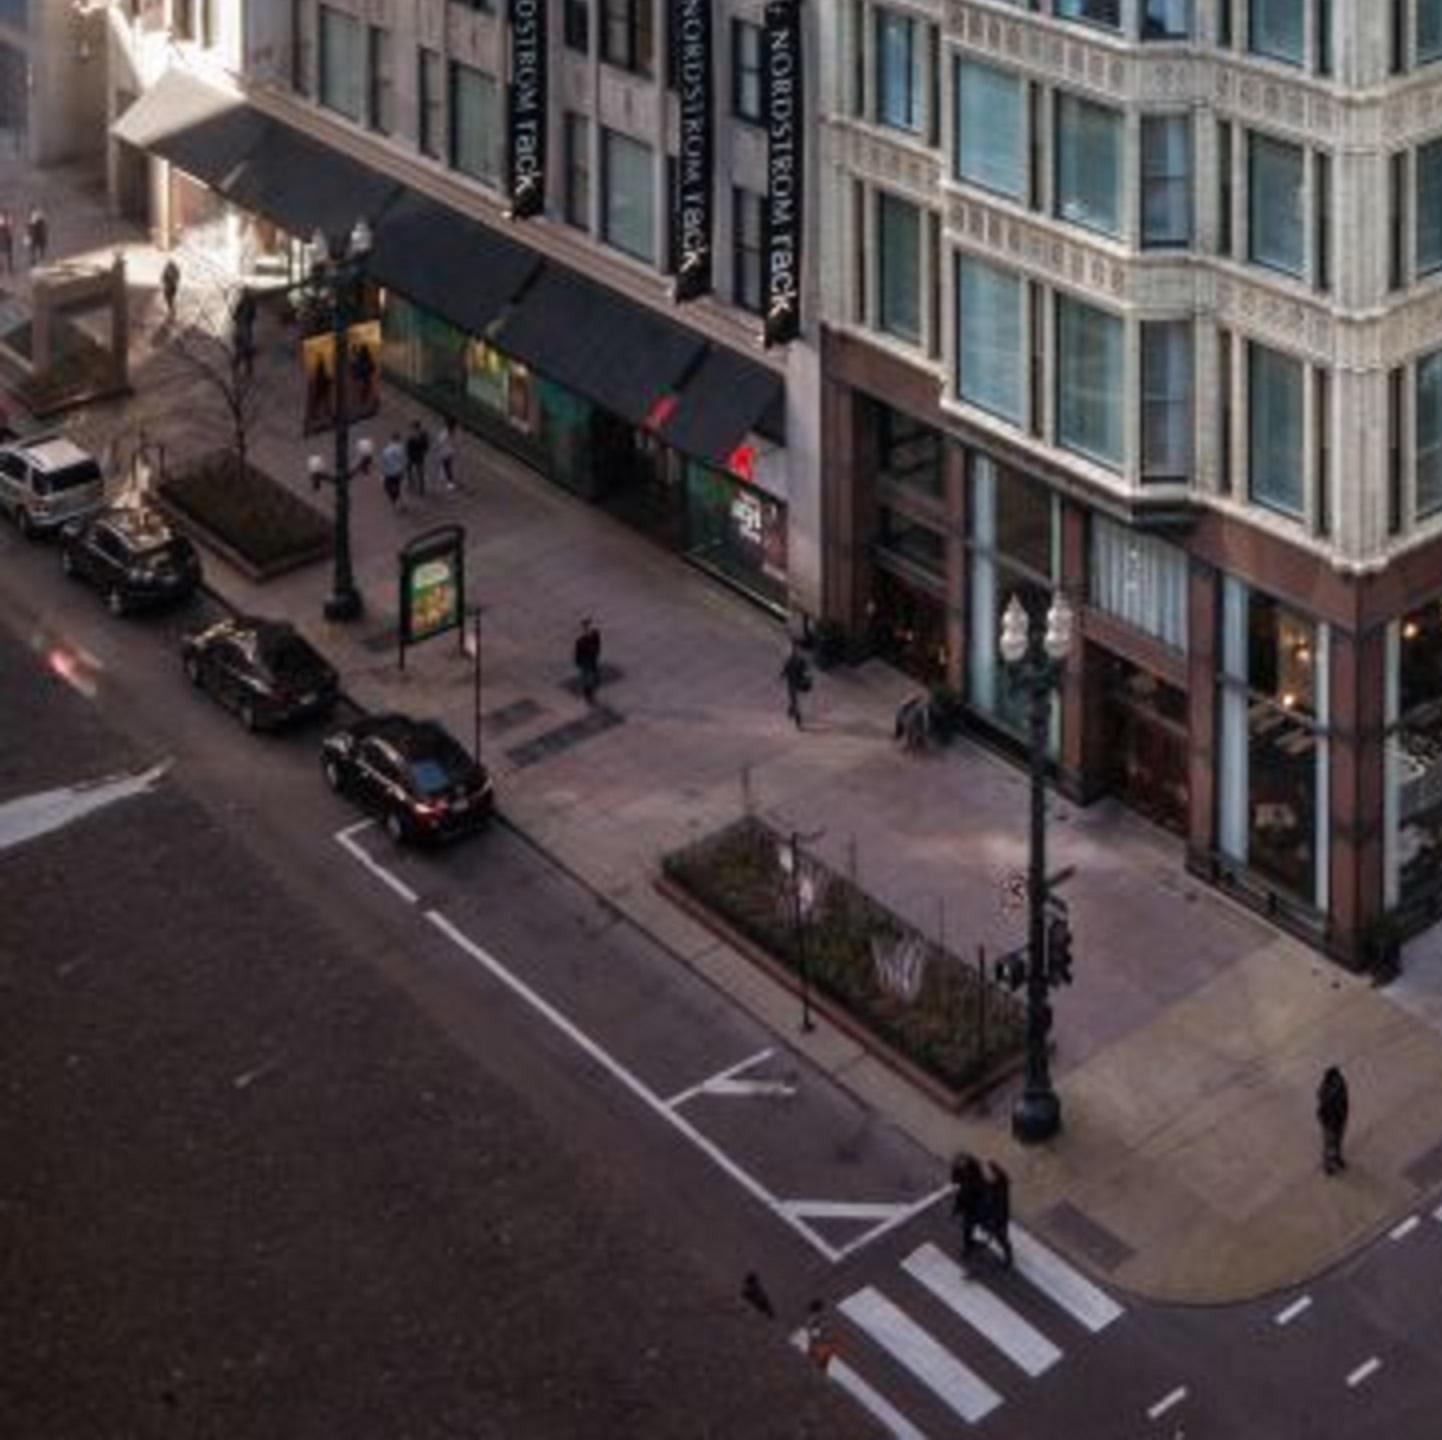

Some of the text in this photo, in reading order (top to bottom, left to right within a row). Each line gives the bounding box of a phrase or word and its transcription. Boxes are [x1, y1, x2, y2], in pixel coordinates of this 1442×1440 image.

[513, 119, 541, 196] rack
[769, 29, 798, 319] NORDSTROM rack
[680, 191, 709, 274] rack
